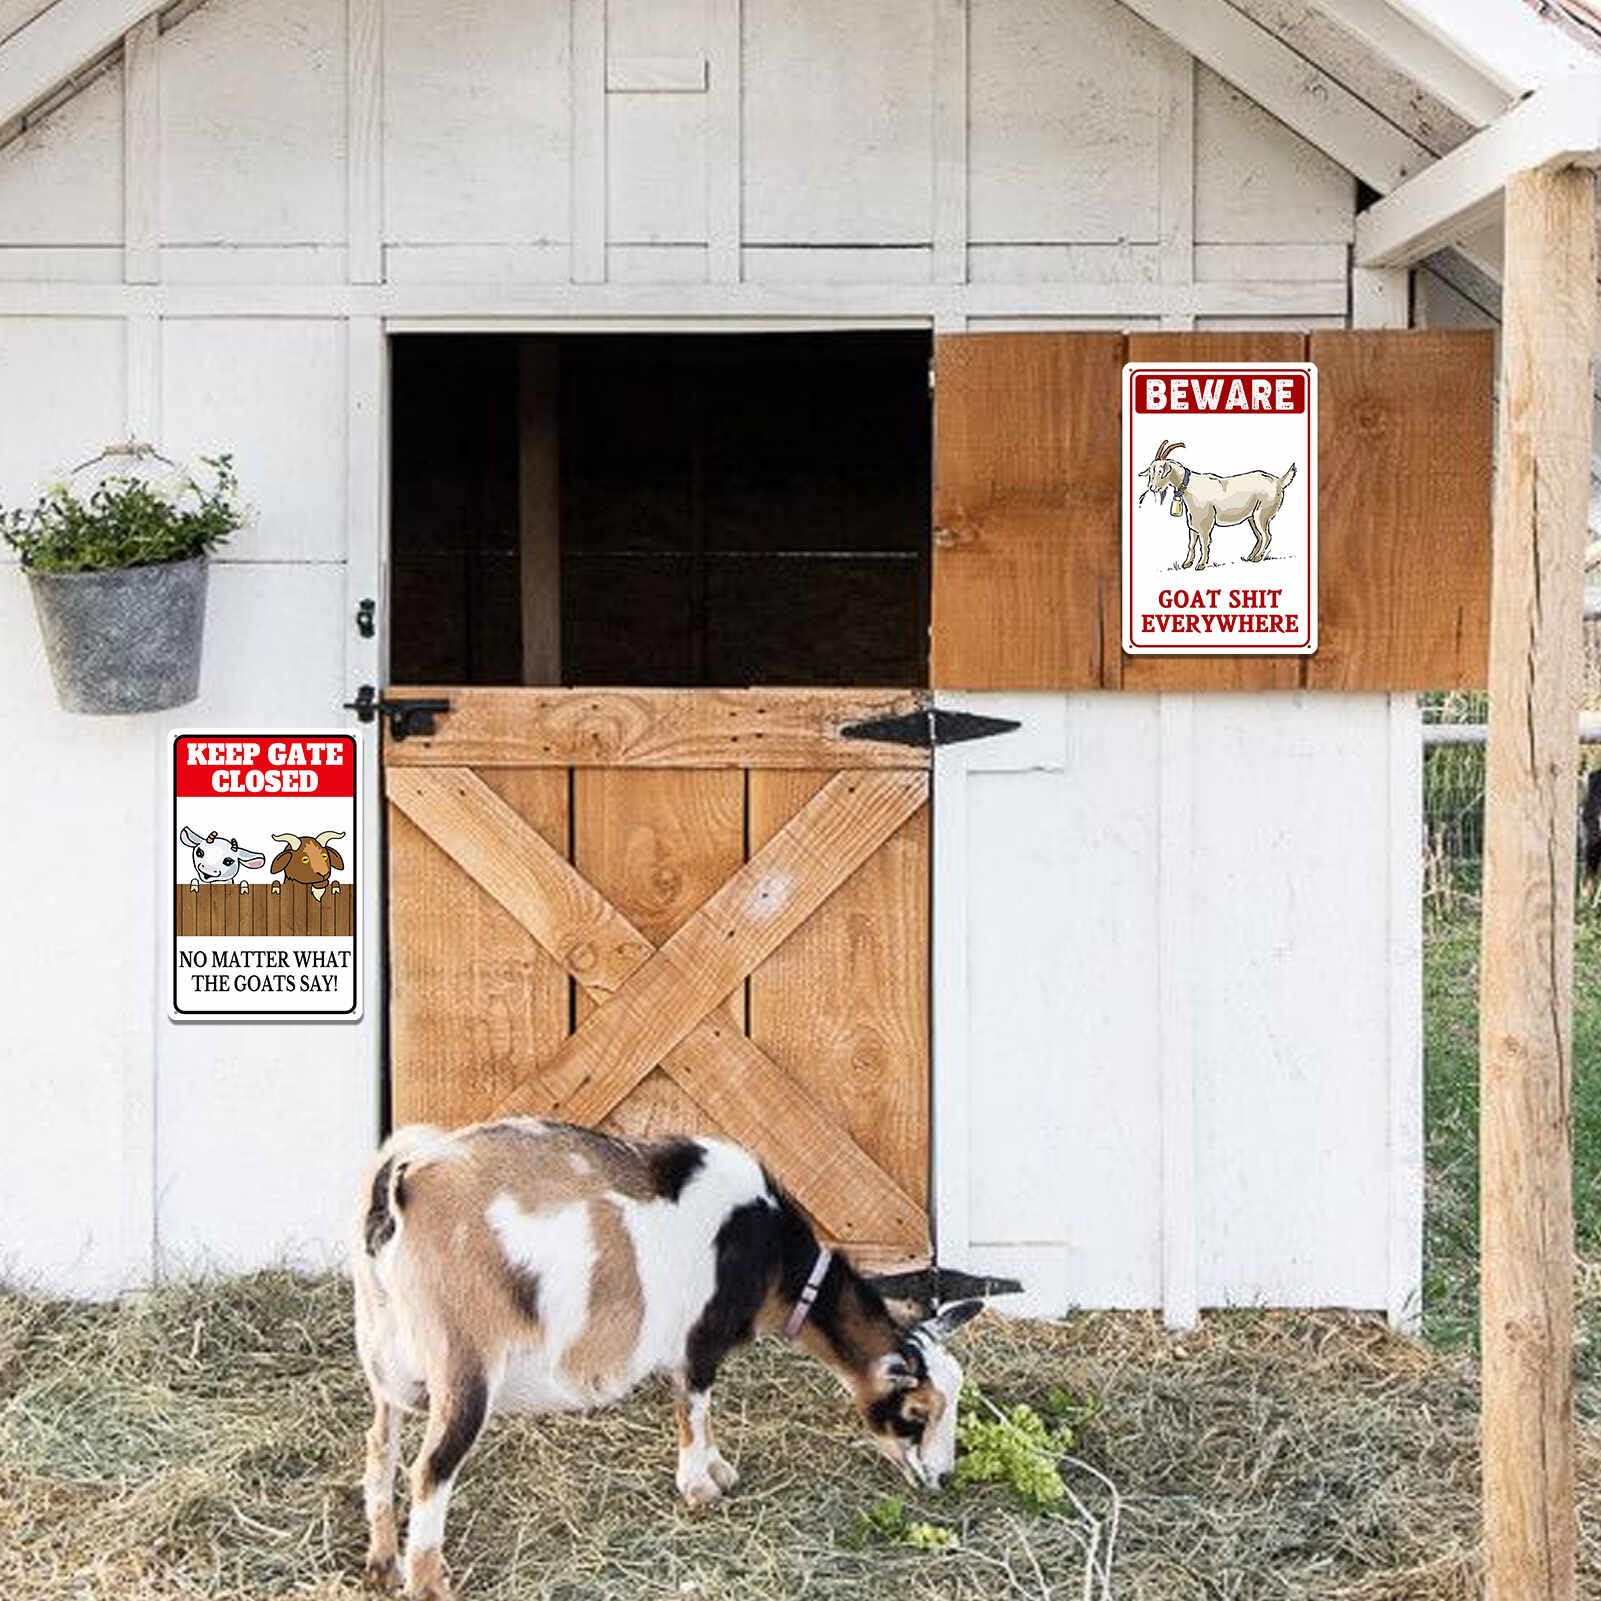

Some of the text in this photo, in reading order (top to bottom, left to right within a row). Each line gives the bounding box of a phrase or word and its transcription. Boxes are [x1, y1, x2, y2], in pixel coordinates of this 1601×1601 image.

[1146, 379, 1294, 410] BEWARE
[1158, 589, 1282, 609] GOAT SHIT
[1141, 614, 1299, 634] EVERYWHERE
[187, 743, 343, 766] KEEP GATE
[211, 770, 319, 793] CLOSED
[179, 951, 351, 968] NO MATTER WHAT
[192, 975, 338, 992] THE GOATS SAY!
